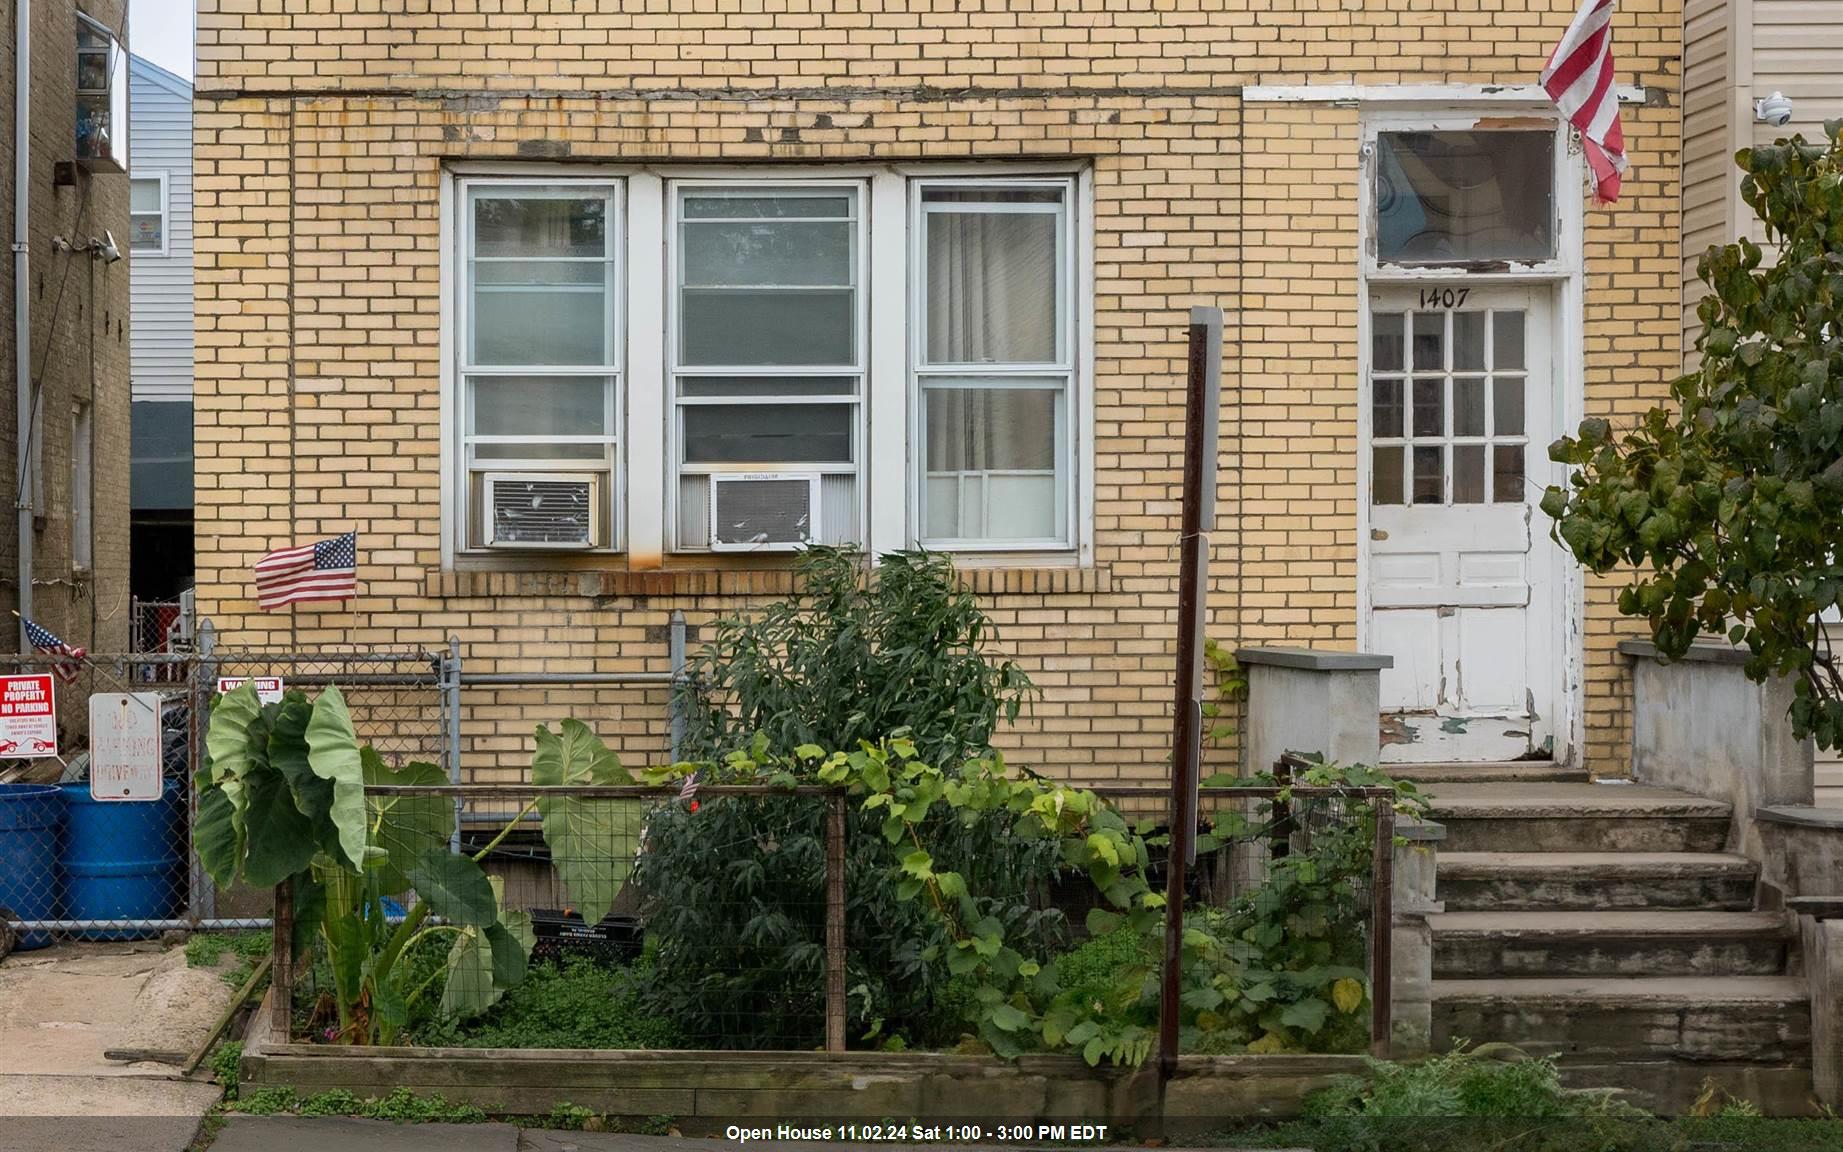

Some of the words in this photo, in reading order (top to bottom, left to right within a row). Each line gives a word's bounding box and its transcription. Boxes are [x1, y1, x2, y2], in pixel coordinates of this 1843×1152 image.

[1420, 287, 1470, 309] 1407
[7, 680, 41, 691] PRIVATE
[225, 680, 276, 690] WAING
[4, 690, 46, 701] PROPERTY
[1, 703, 13, 714] NO
[15, 702, 49, 713] PARKING
